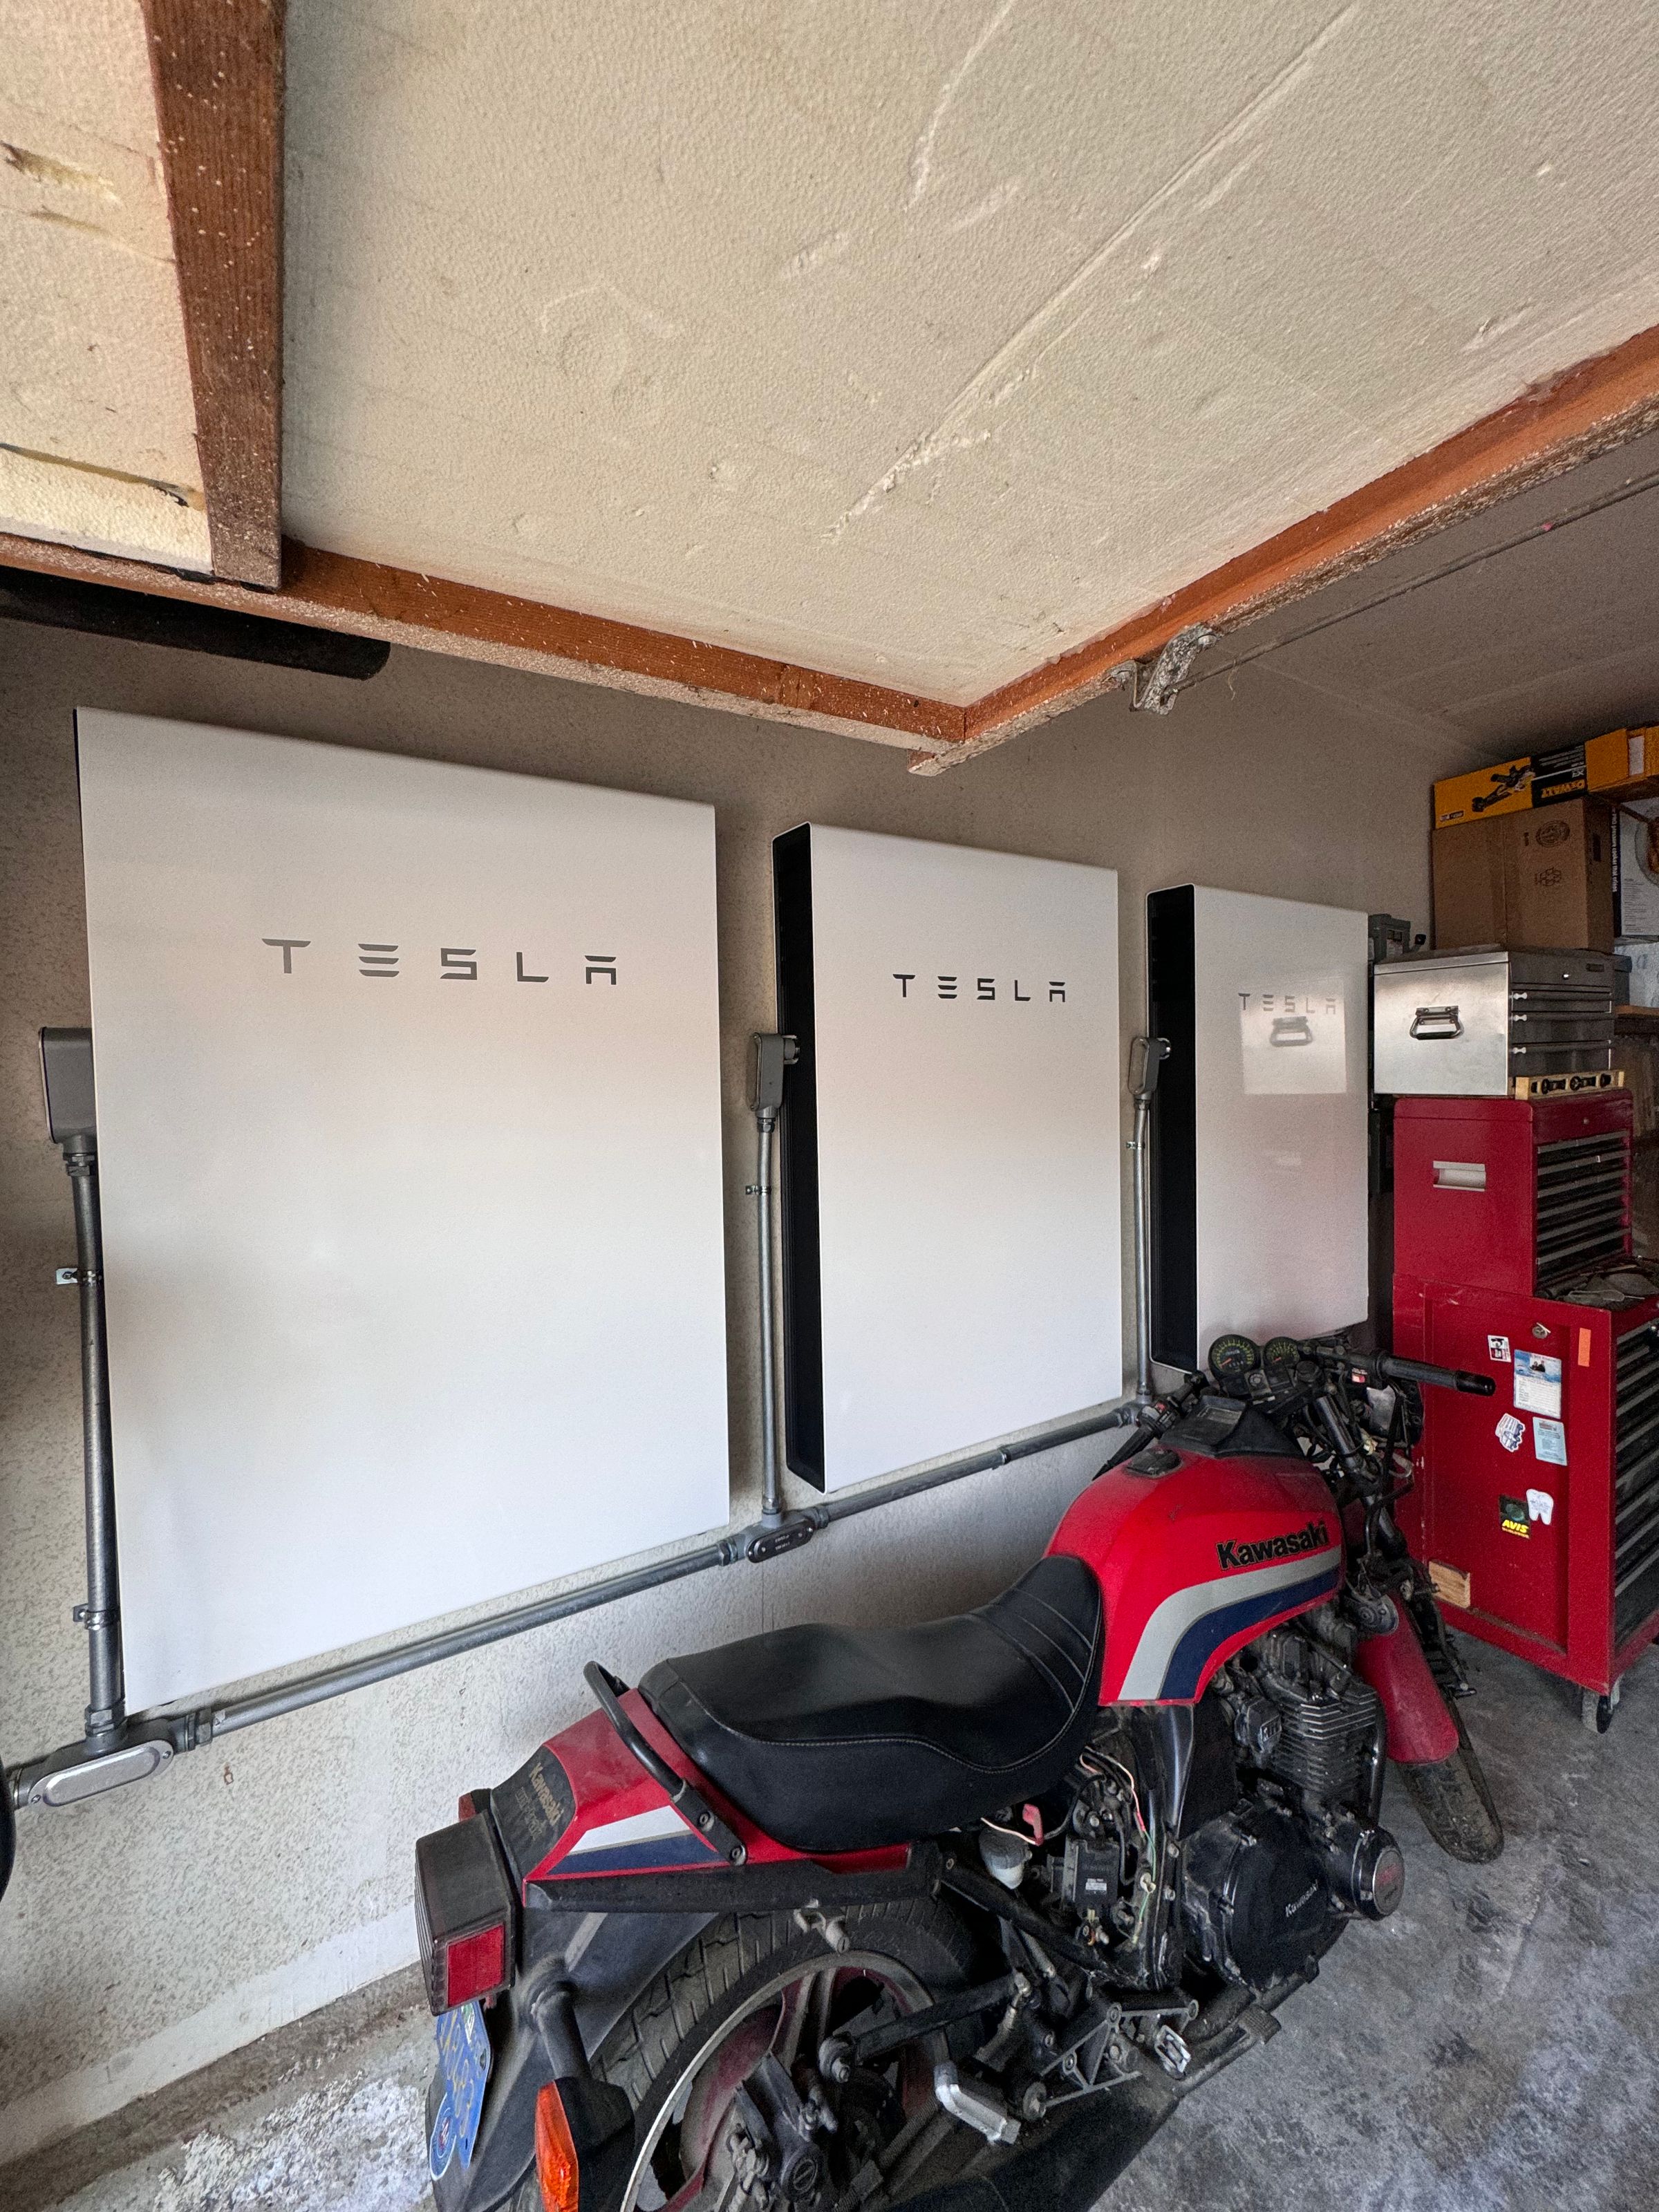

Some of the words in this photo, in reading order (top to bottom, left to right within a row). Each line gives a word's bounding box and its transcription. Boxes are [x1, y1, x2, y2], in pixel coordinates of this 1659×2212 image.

[1541, 779, 1585, 798] DEWALT
[261, 938, 617, 986] TESLA
[892, 973, 1065, 1002] TESLA
[1238, 993, 1335, 1015] TESLA
[1501, 1519, 1529, 1533] AVIS
[1216, 1520, 1329, 1571] Kawasaki
[529, 1762, 564, 1826] Kawasaki
